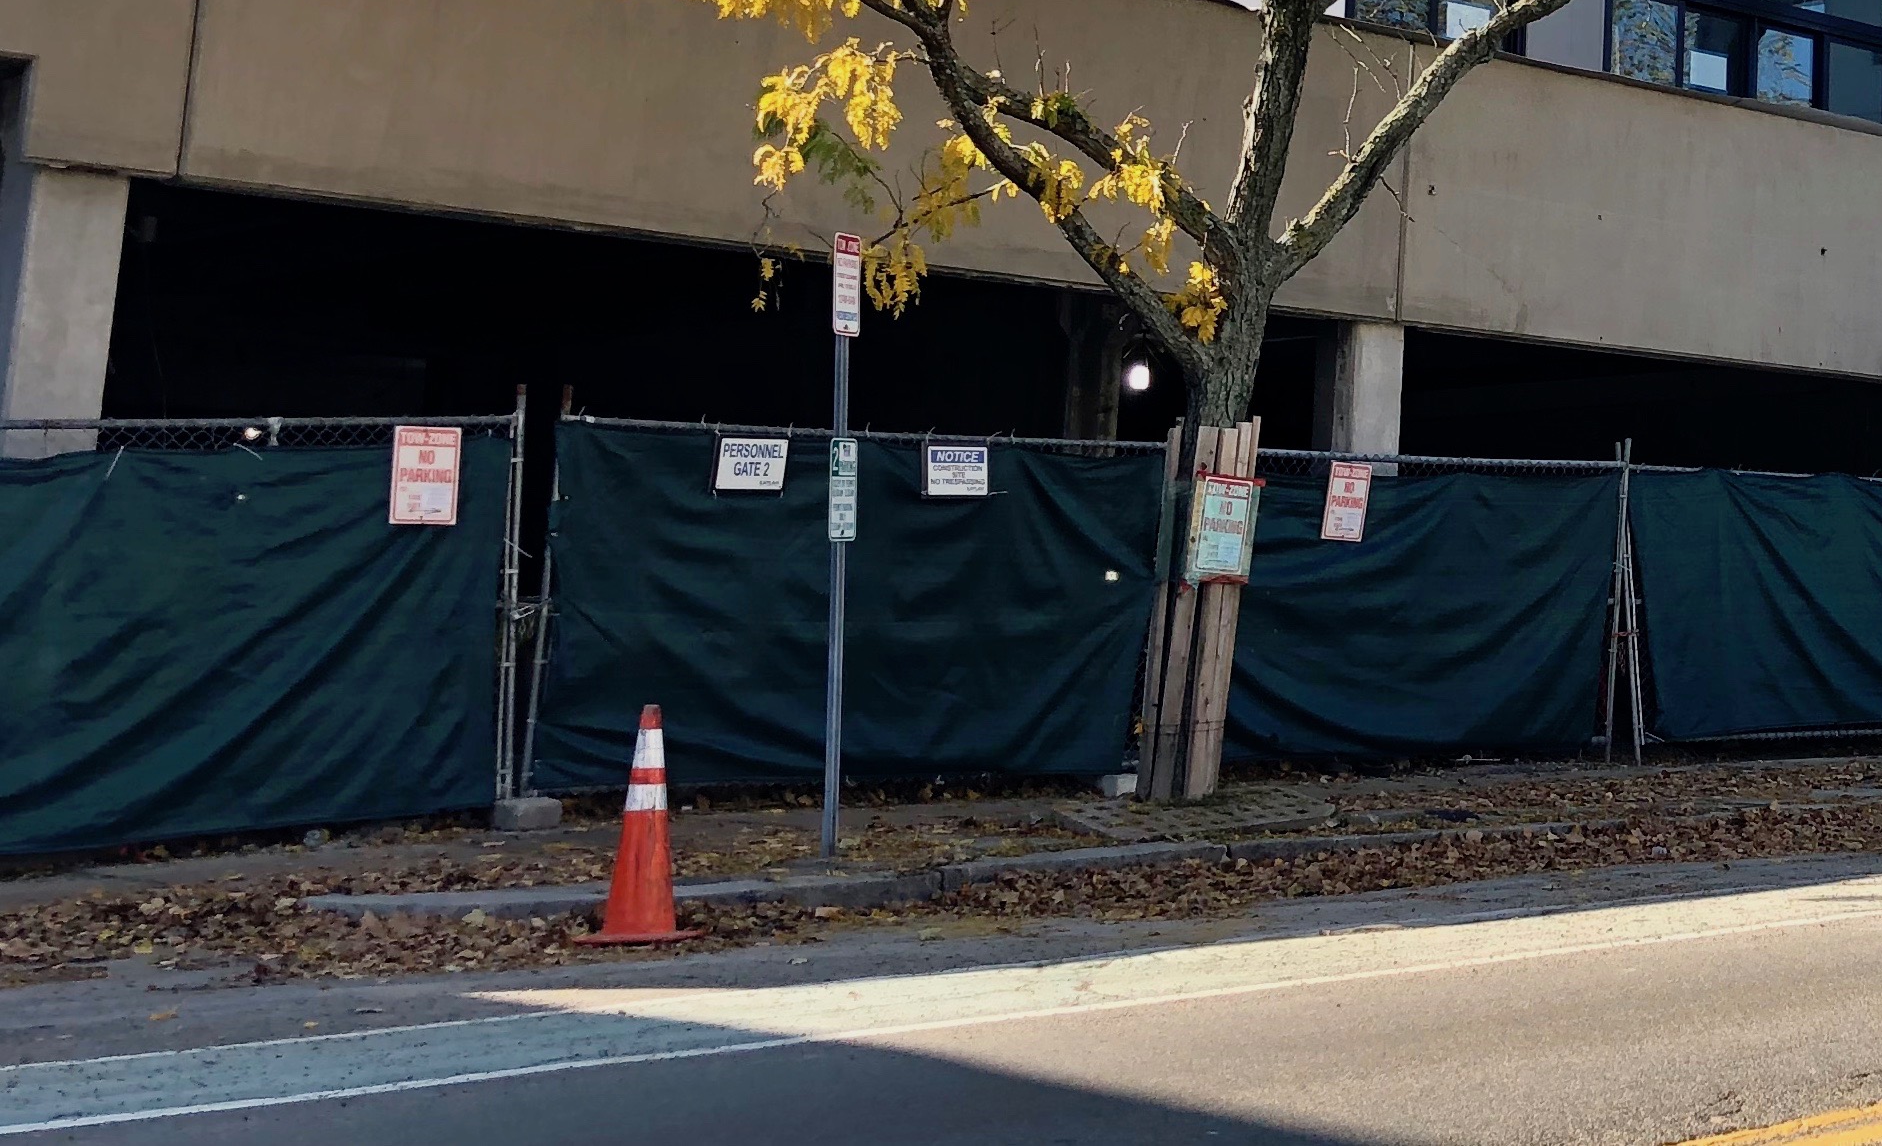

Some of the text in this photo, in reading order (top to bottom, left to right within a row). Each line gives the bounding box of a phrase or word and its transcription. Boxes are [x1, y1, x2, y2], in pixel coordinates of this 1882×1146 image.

[419, 450, 435, 465] NO
[723, 443, 784, 459] PERSONNEL
[832, 446, 839, 471] 2
[936, 451, 980, 463] NOTICE
[400, 467, 452, 484] PARKING
[733, 461, 770, 477] GATE 2
[932, 464, 983, 472] CONSTRUCTION
[1219, 501, 1233, 515] NO
[1331, 495, 1363, 509] PARKING
[1203, 517, 1243, 534] PARKING
